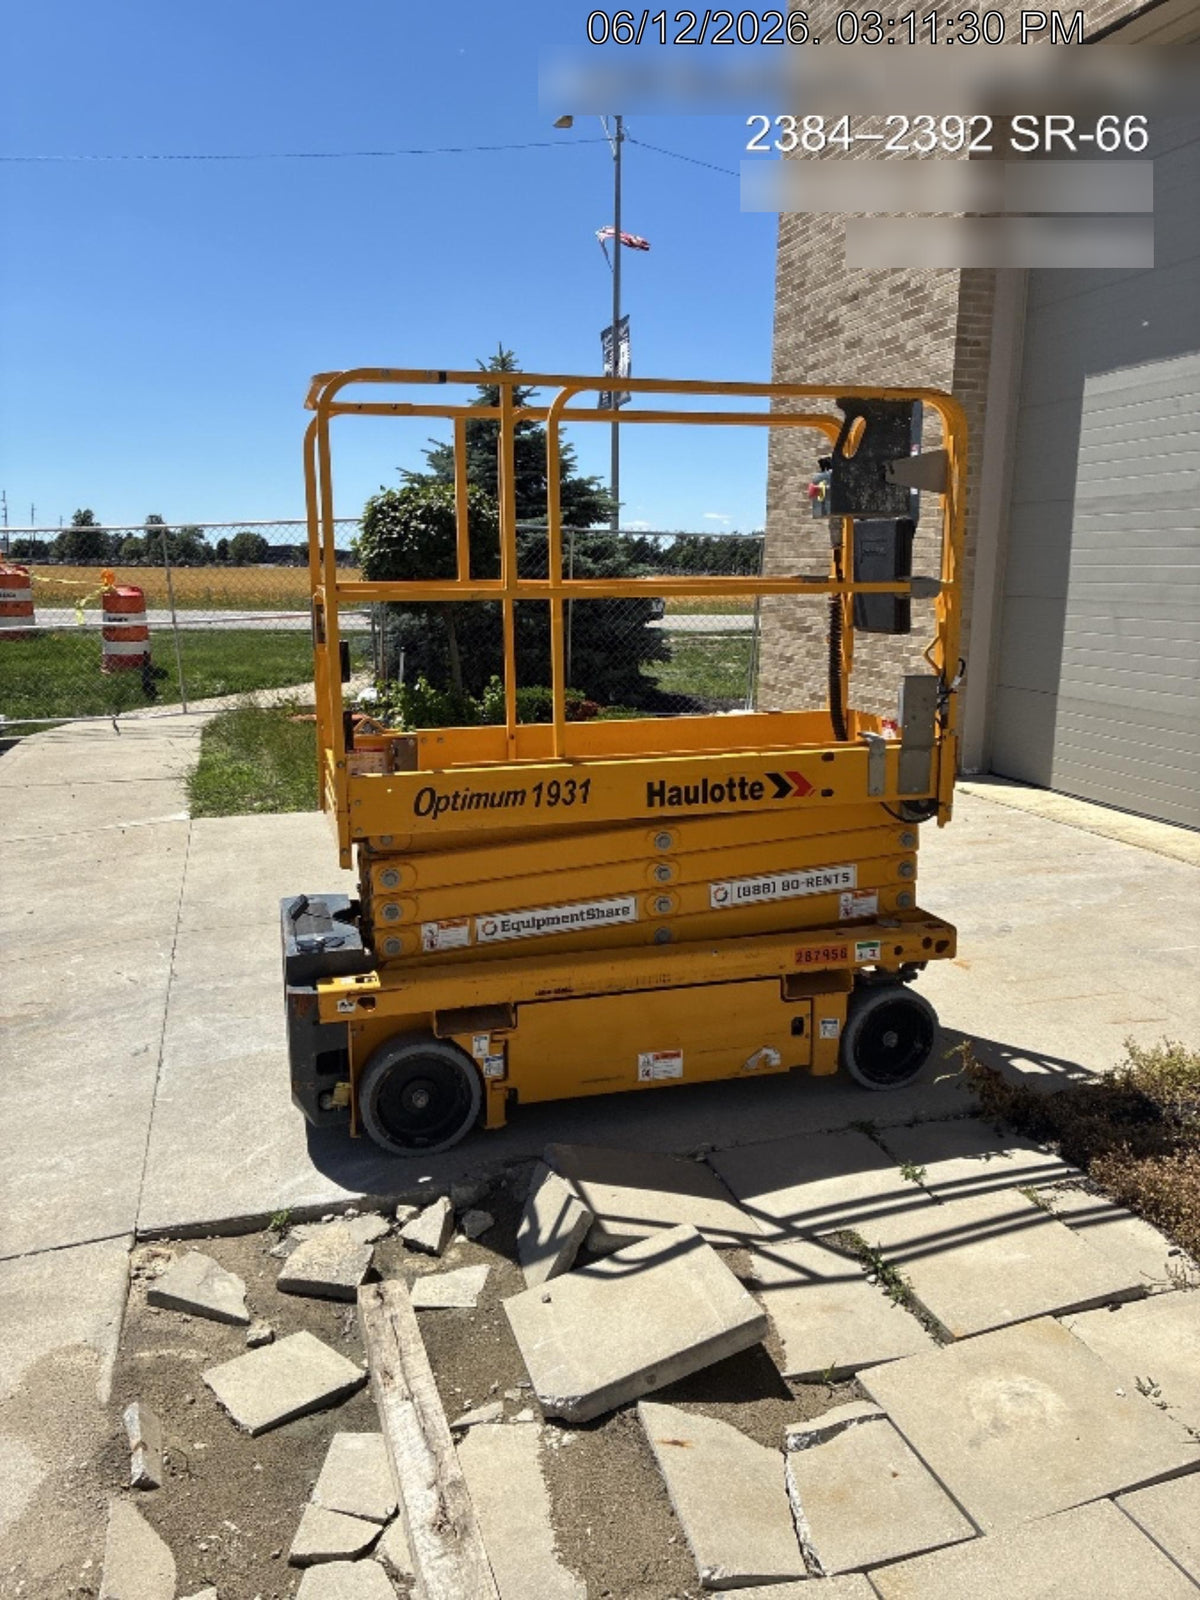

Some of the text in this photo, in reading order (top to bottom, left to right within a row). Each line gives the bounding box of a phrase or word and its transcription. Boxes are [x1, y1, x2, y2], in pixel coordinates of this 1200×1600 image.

[414, 778, 592, 819] Optimum 1931
[647, 777, 765, 807] Haulotte
[501, 905, 630, 932] EquipmentShare
